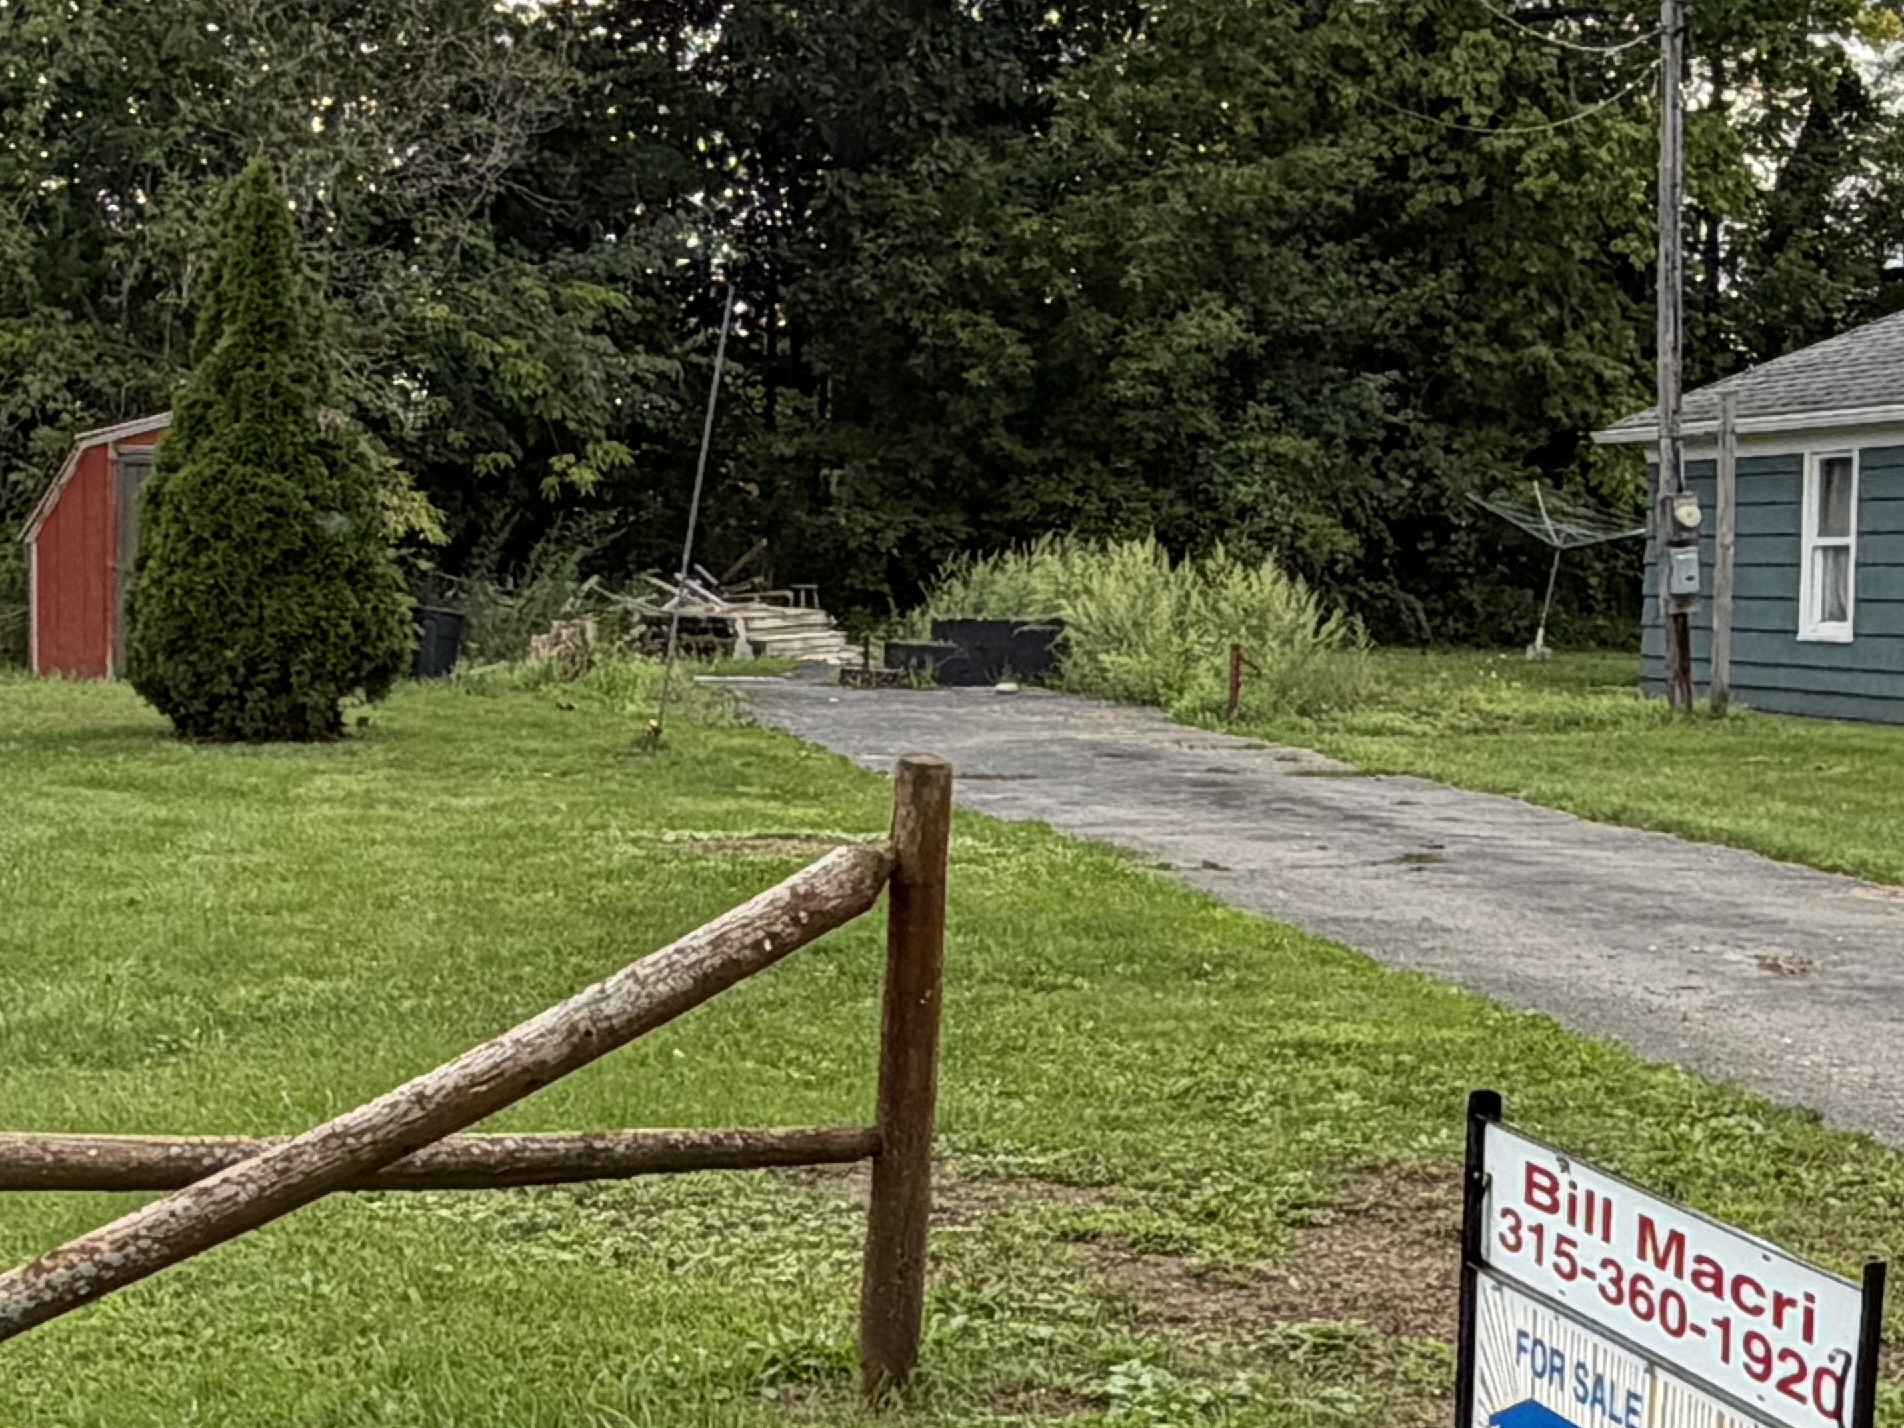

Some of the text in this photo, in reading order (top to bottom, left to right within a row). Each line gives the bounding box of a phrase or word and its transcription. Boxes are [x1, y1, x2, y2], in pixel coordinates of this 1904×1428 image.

[1498, 1206, 1848, 1421] 315-360-1920
[1523, 1160, 1816, 1345] Bill Macri
[1515, 1328, 1566, 1393] FOR
